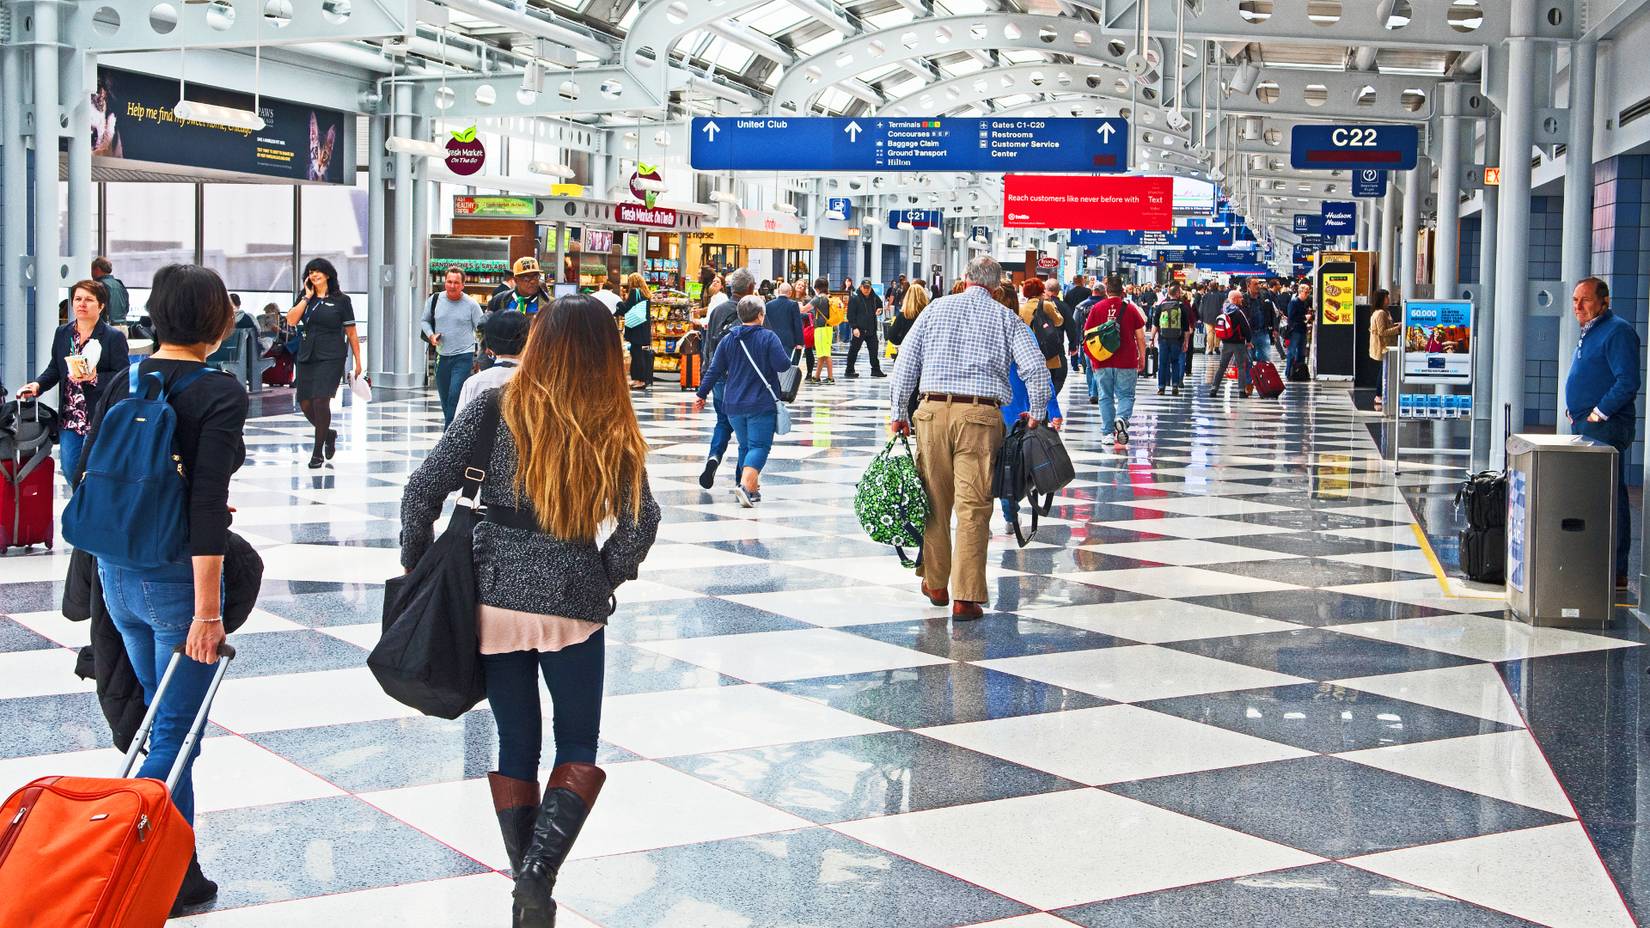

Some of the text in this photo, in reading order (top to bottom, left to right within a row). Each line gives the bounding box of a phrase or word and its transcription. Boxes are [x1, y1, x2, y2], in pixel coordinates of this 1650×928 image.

[127, 102, 145, 121] Help
[146, 107, 158, 119] me
[157, 106, 173, 124] find
[737, 120, 788, 129] United Club
[1016, 121, 1045, 129] C1-C20
[888, 130, 930, 138] Concourses
[1332, 128, 1377, 147] C22
[888, 140, 918, 148] Baggage
[448, 149, 483, 157] resh Market
[914, 149, 947, 157] Transport
[888, 158, 911, 166] Hilton
[1008, 194, 1029, 202] Reach
[1030, 195, 1066, 203] customers
[1066, 195, 1079, 203] like
[1101, 195, 1123, 203] before
[1124, 196, 1140, 204] with
[1148, 196, 1163, 204] Text
[621, 206, 636, 221] Fresh
[636, 208, 654, 223] Market
[907, 212, 925, 220] C21
[1325, 211, 1352, 219] Hudson
[1107, 309, 1117, 317] 17
